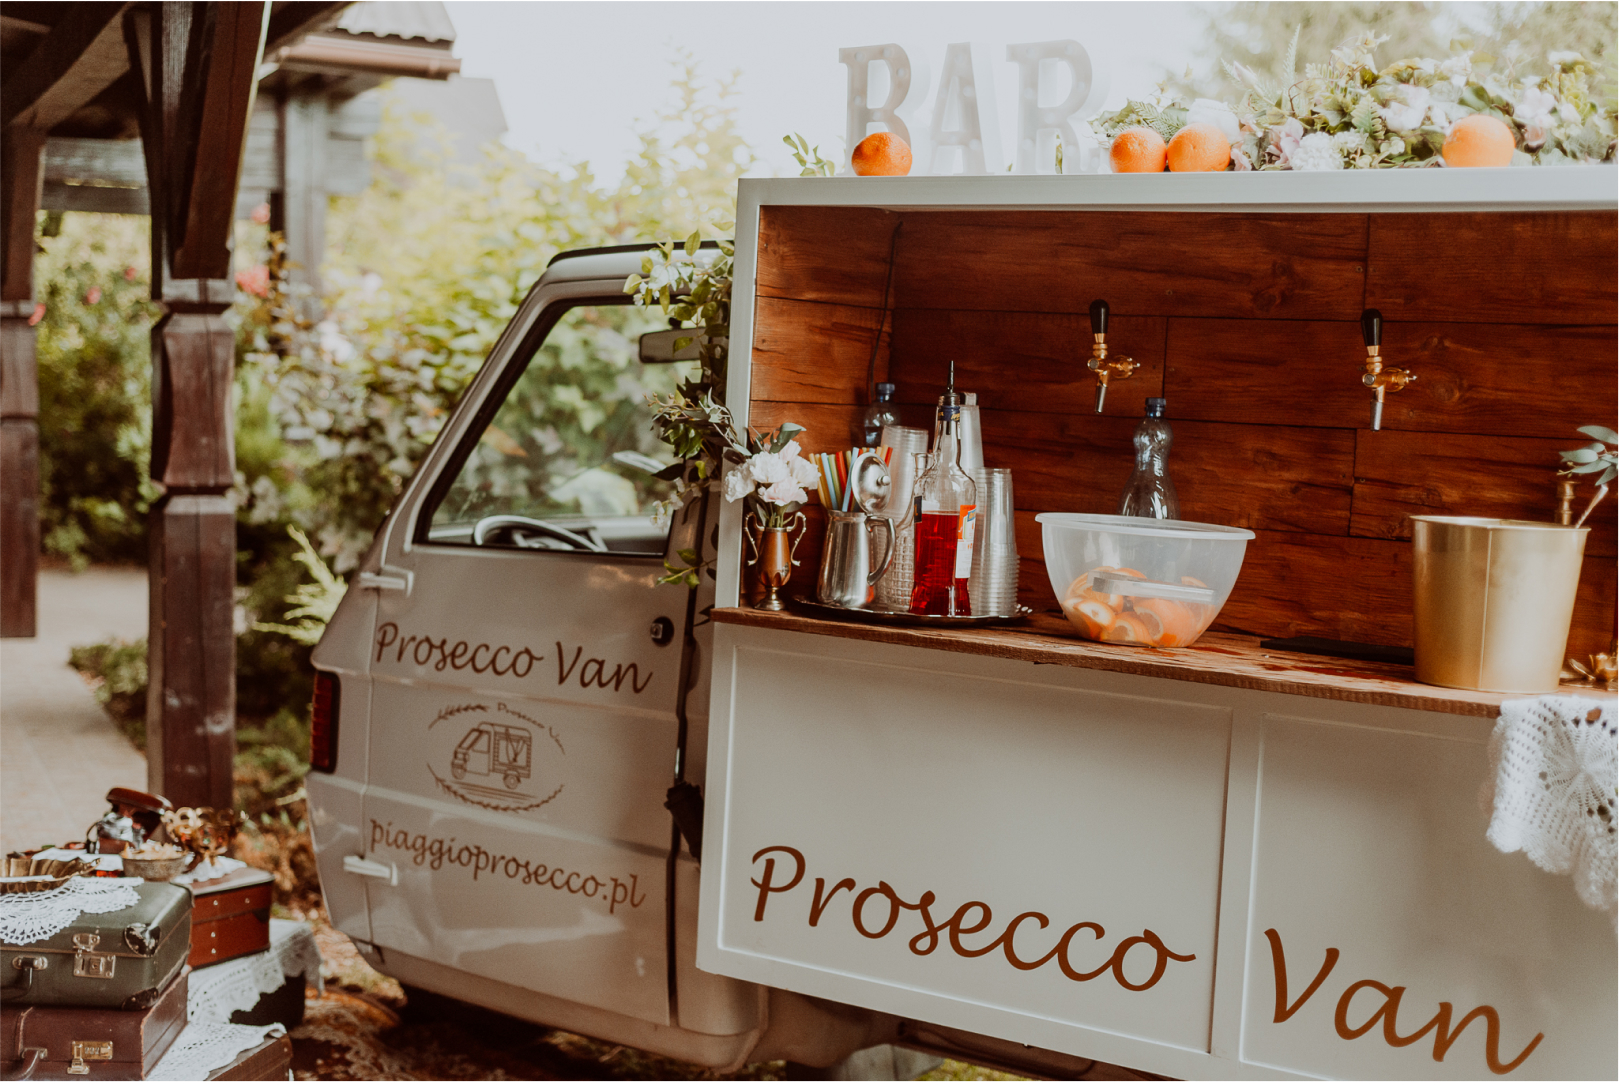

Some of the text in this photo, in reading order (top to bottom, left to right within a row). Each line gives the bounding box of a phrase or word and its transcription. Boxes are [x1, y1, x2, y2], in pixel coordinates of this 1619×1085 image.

[837, 38, 1103, 175] BAR
[375, 621, 653, 694] Prosecco Van
[369, 818, 646, 915] piaggioprosecco.pl
[750, 845, 1545, 1076] Prosecco Van
